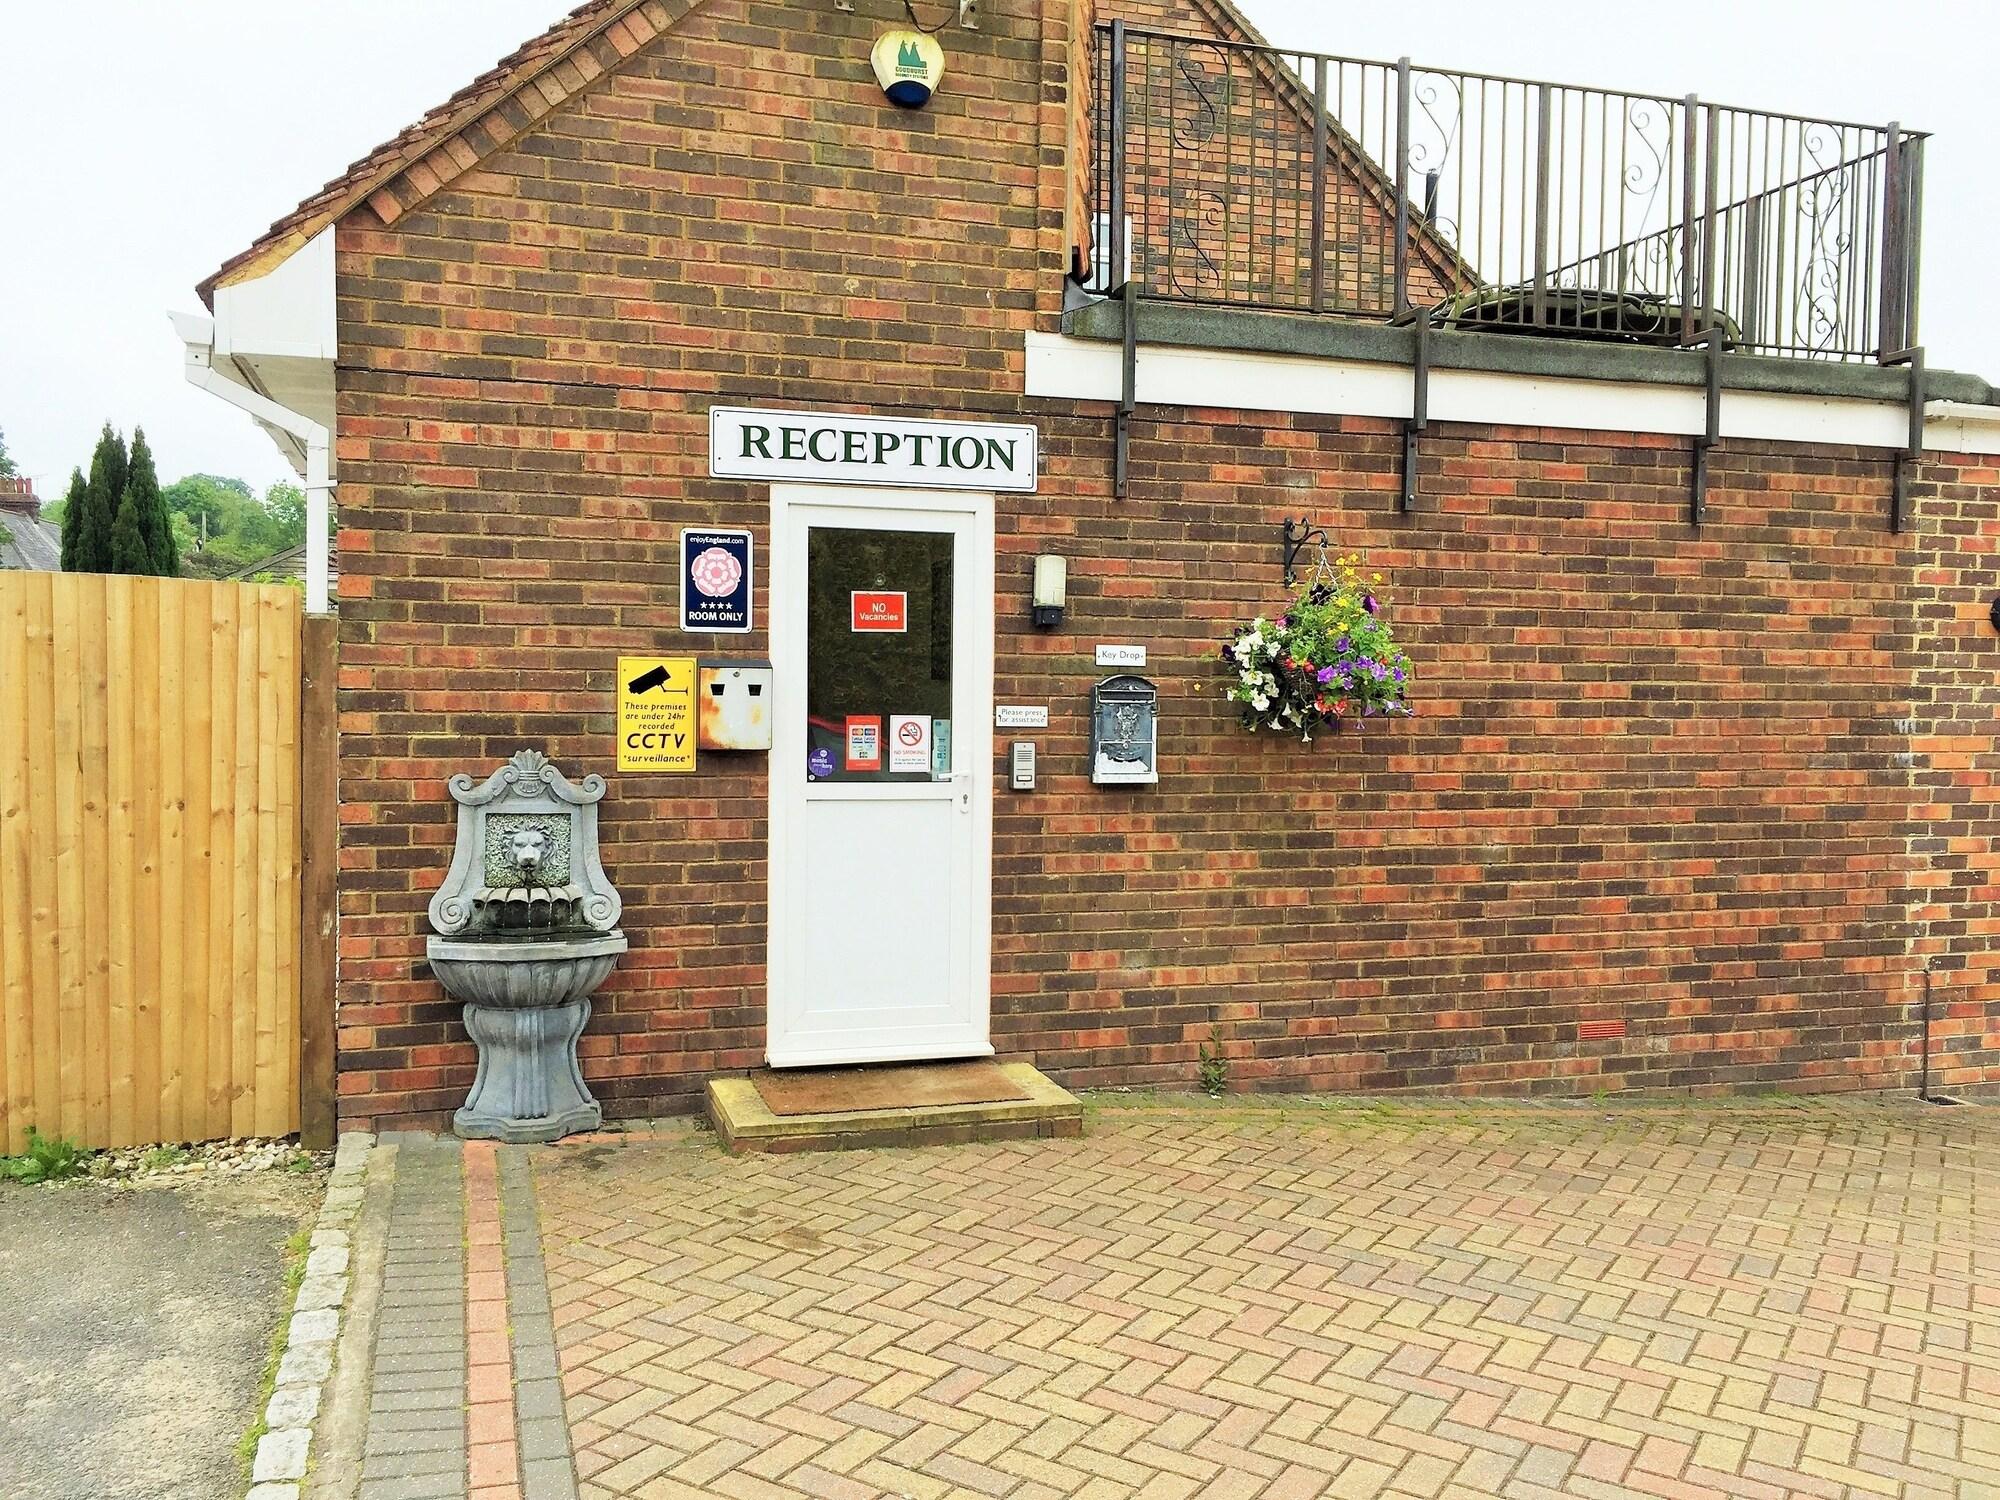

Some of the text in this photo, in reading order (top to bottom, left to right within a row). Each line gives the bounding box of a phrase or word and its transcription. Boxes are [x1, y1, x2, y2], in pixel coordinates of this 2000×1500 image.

[738, 424, 1018, 472] RECEPTION
[872, 602, 886, 612] NO
[689, 611, 743, 622] ROOM ONLY
[860, 612, 898, 620] Vacancies
[1102, 650, 1140, 660] Key Drop
[624, 702, 648, 710] These
[626, 733, 686, 748] CCTV
